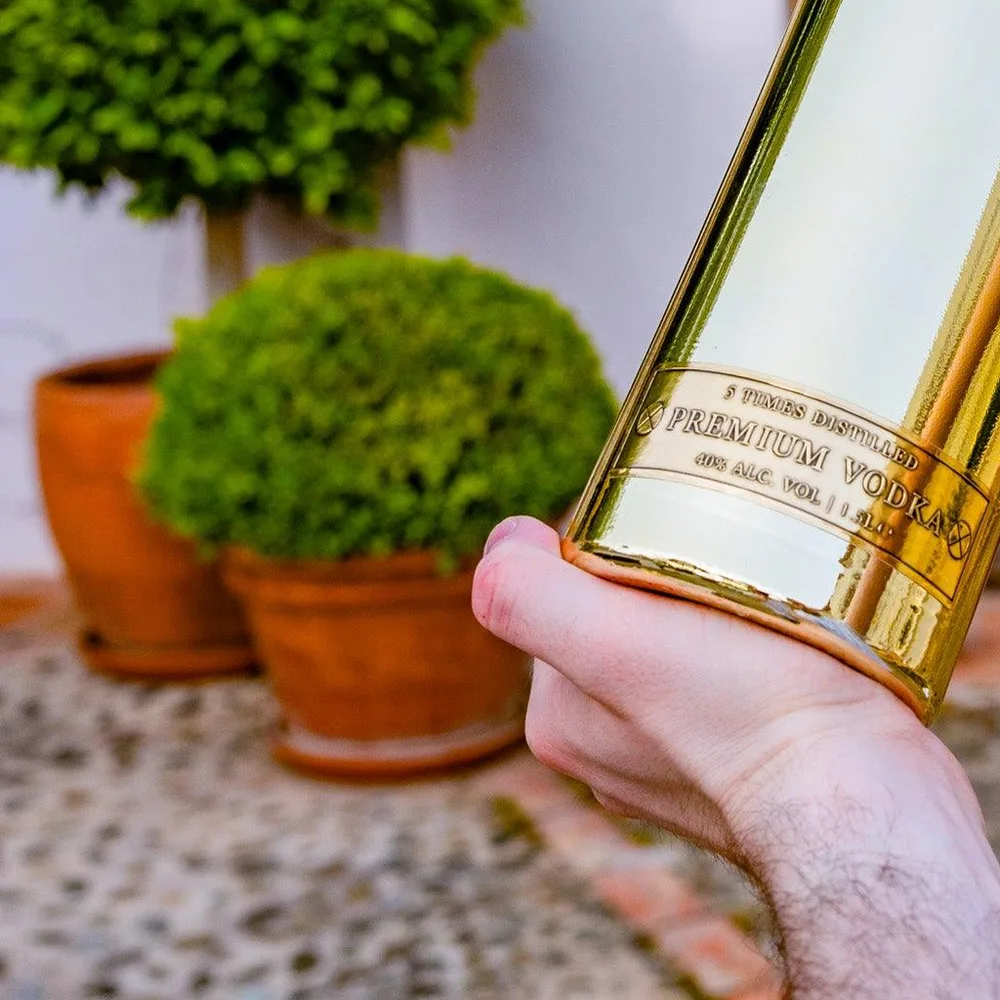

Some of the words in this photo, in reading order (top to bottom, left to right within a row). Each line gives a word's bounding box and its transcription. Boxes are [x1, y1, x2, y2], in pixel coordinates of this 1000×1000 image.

[666, 406, 832, 473] PREMIUM
[844, 455, 944, 538] VODKA
[723, 383, 736, 400] 5
[742, 387, 808, 420] TIMES
[811, 409, 920, 472] DISTILLED
[694, 451, 728, 473] 40%
[782, 474, 821, 506] VOL
